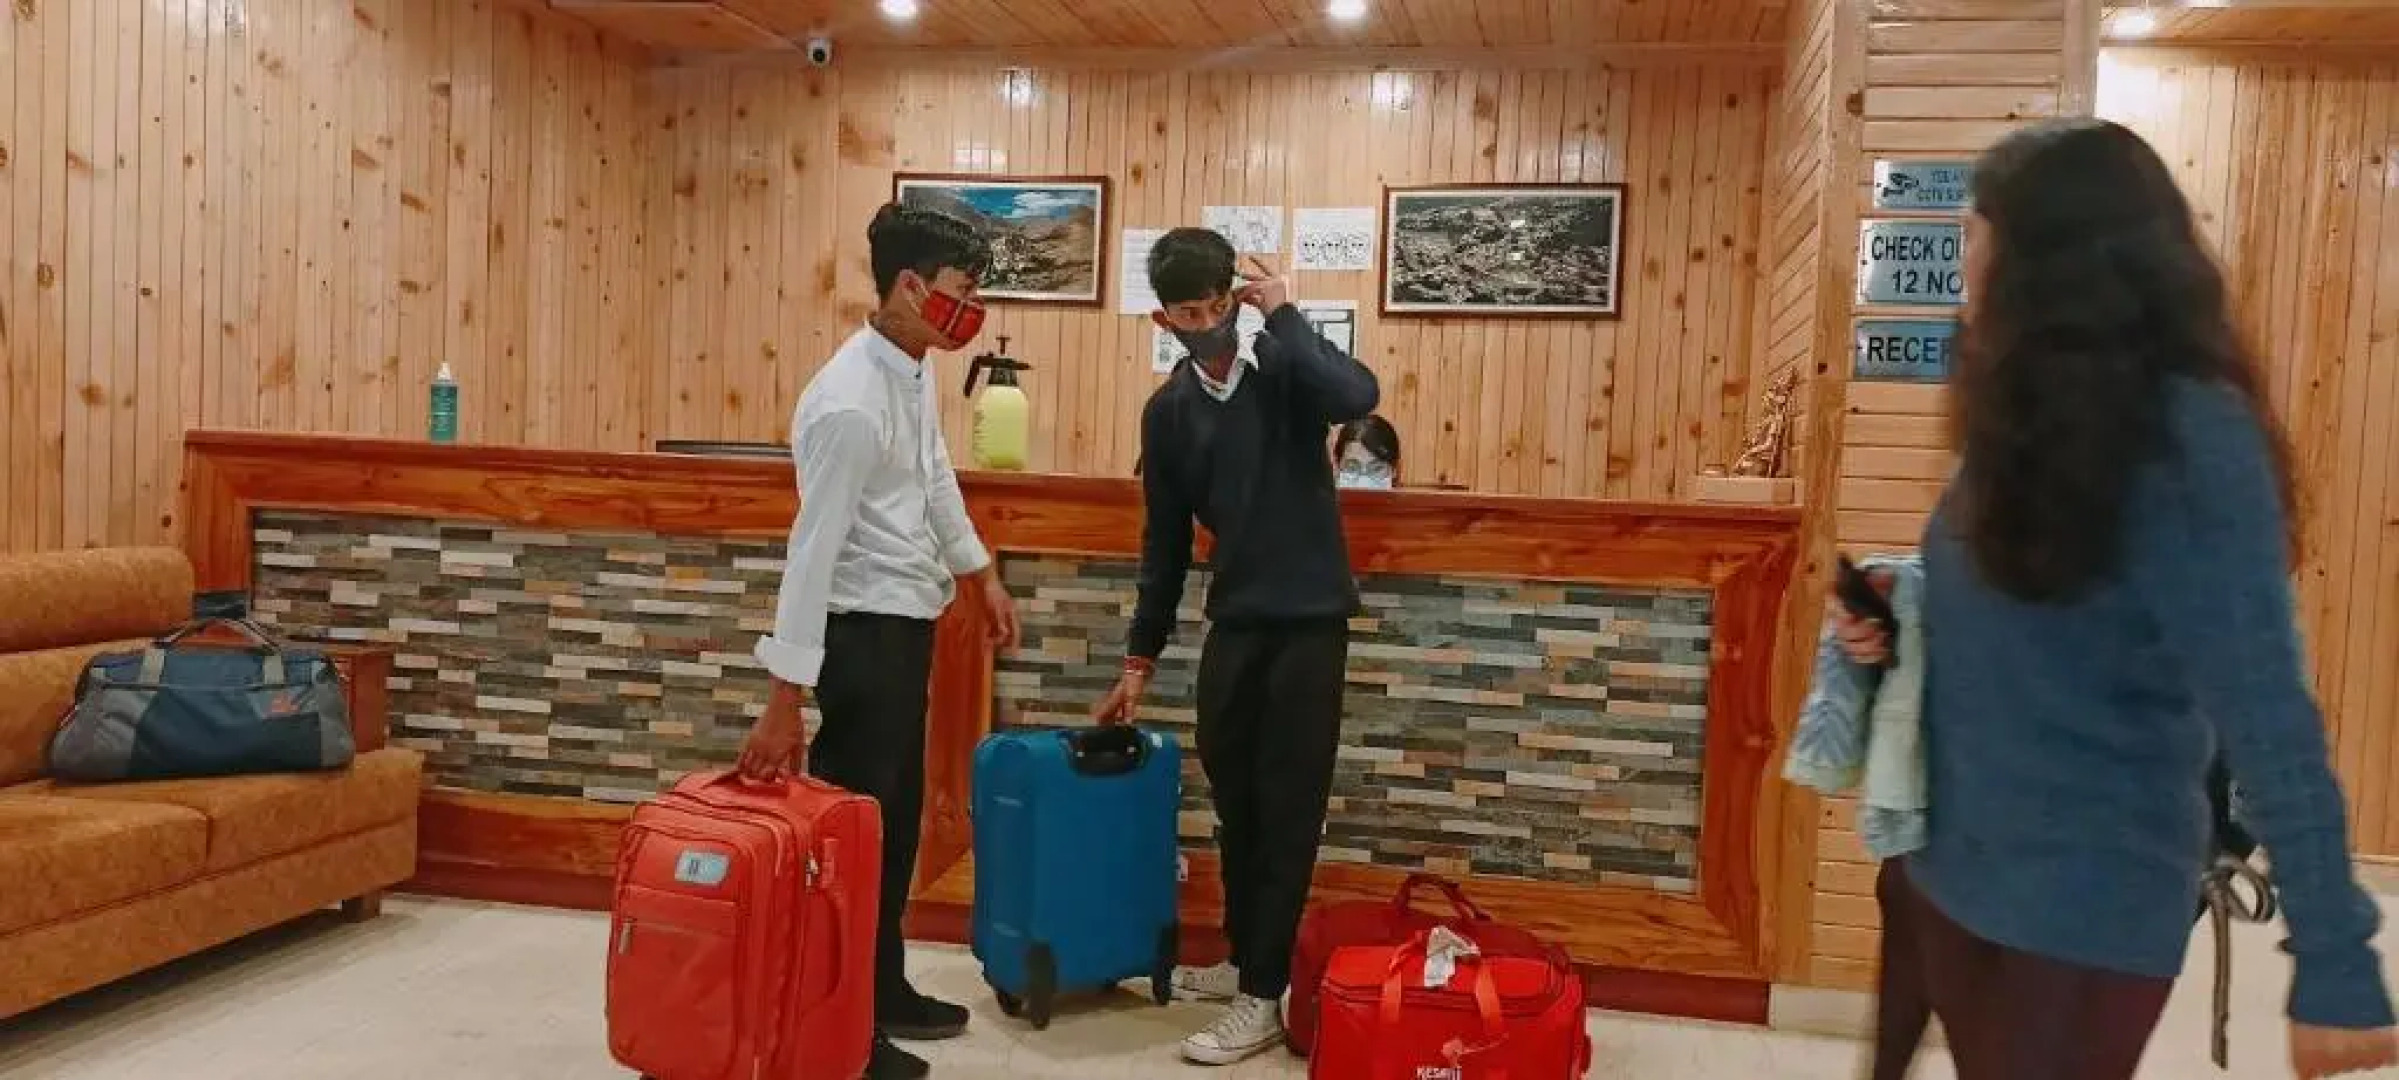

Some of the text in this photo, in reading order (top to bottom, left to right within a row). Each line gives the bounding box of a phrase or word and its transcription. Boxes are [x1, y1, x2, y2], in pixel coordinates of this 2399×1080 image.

[1872, 236, 1935, 260] CHECK
[1892, 269, 1964, 295] 12 NO
